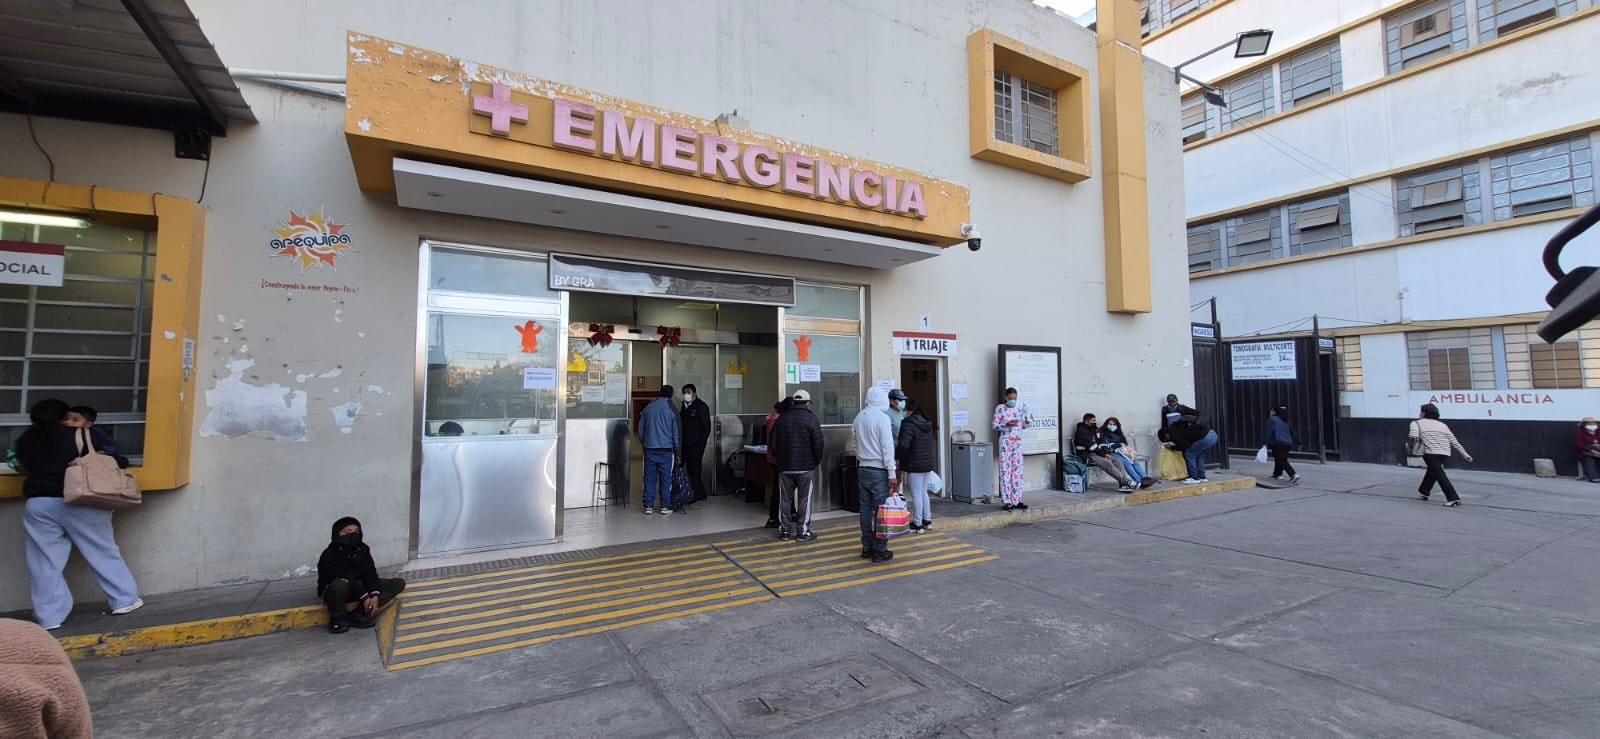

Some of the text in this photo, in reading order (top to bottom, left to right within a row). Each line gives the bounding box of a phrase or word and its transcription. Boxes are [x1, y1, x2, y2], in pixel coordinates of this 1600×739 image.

[553, 98, 928, 220] EMERGENCIA
[555, 275, 595, 288] BY GRA
[923, 316, 928, 327] 1
[913, 339, 948, 354] TRIAJE
[787, 364, 796, 382] 4
[1429, 393, 1554, 404] AMBULANCIA
